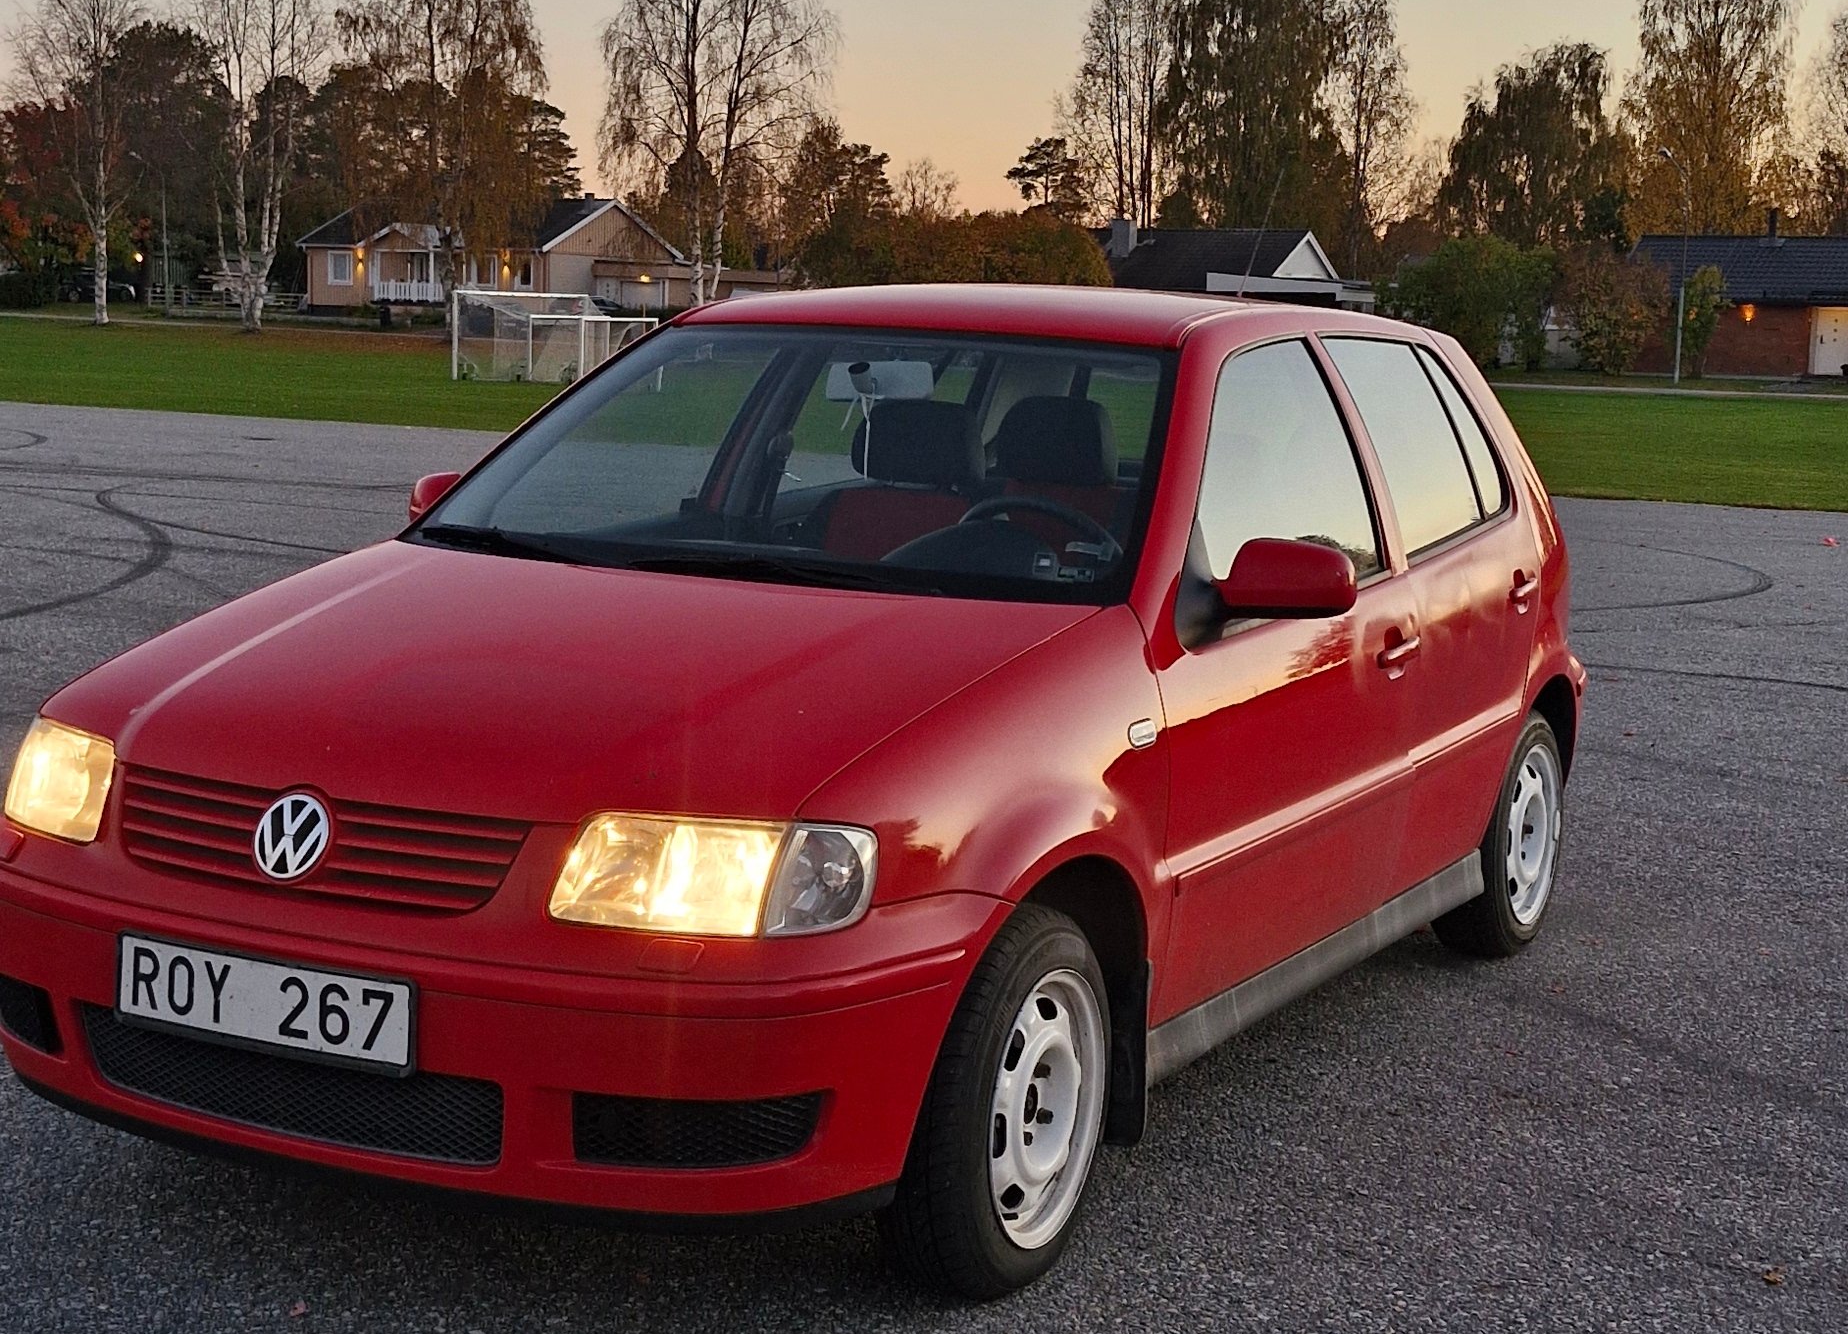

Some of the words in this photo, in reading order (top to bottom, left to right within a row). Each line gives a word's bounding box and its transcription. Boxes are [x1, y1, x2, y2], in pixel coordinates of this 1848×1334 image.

[255, 794, 329, 878] VW
[131, 945, 232, 1024] ROY
[278, 976, 394, 1052] 267
